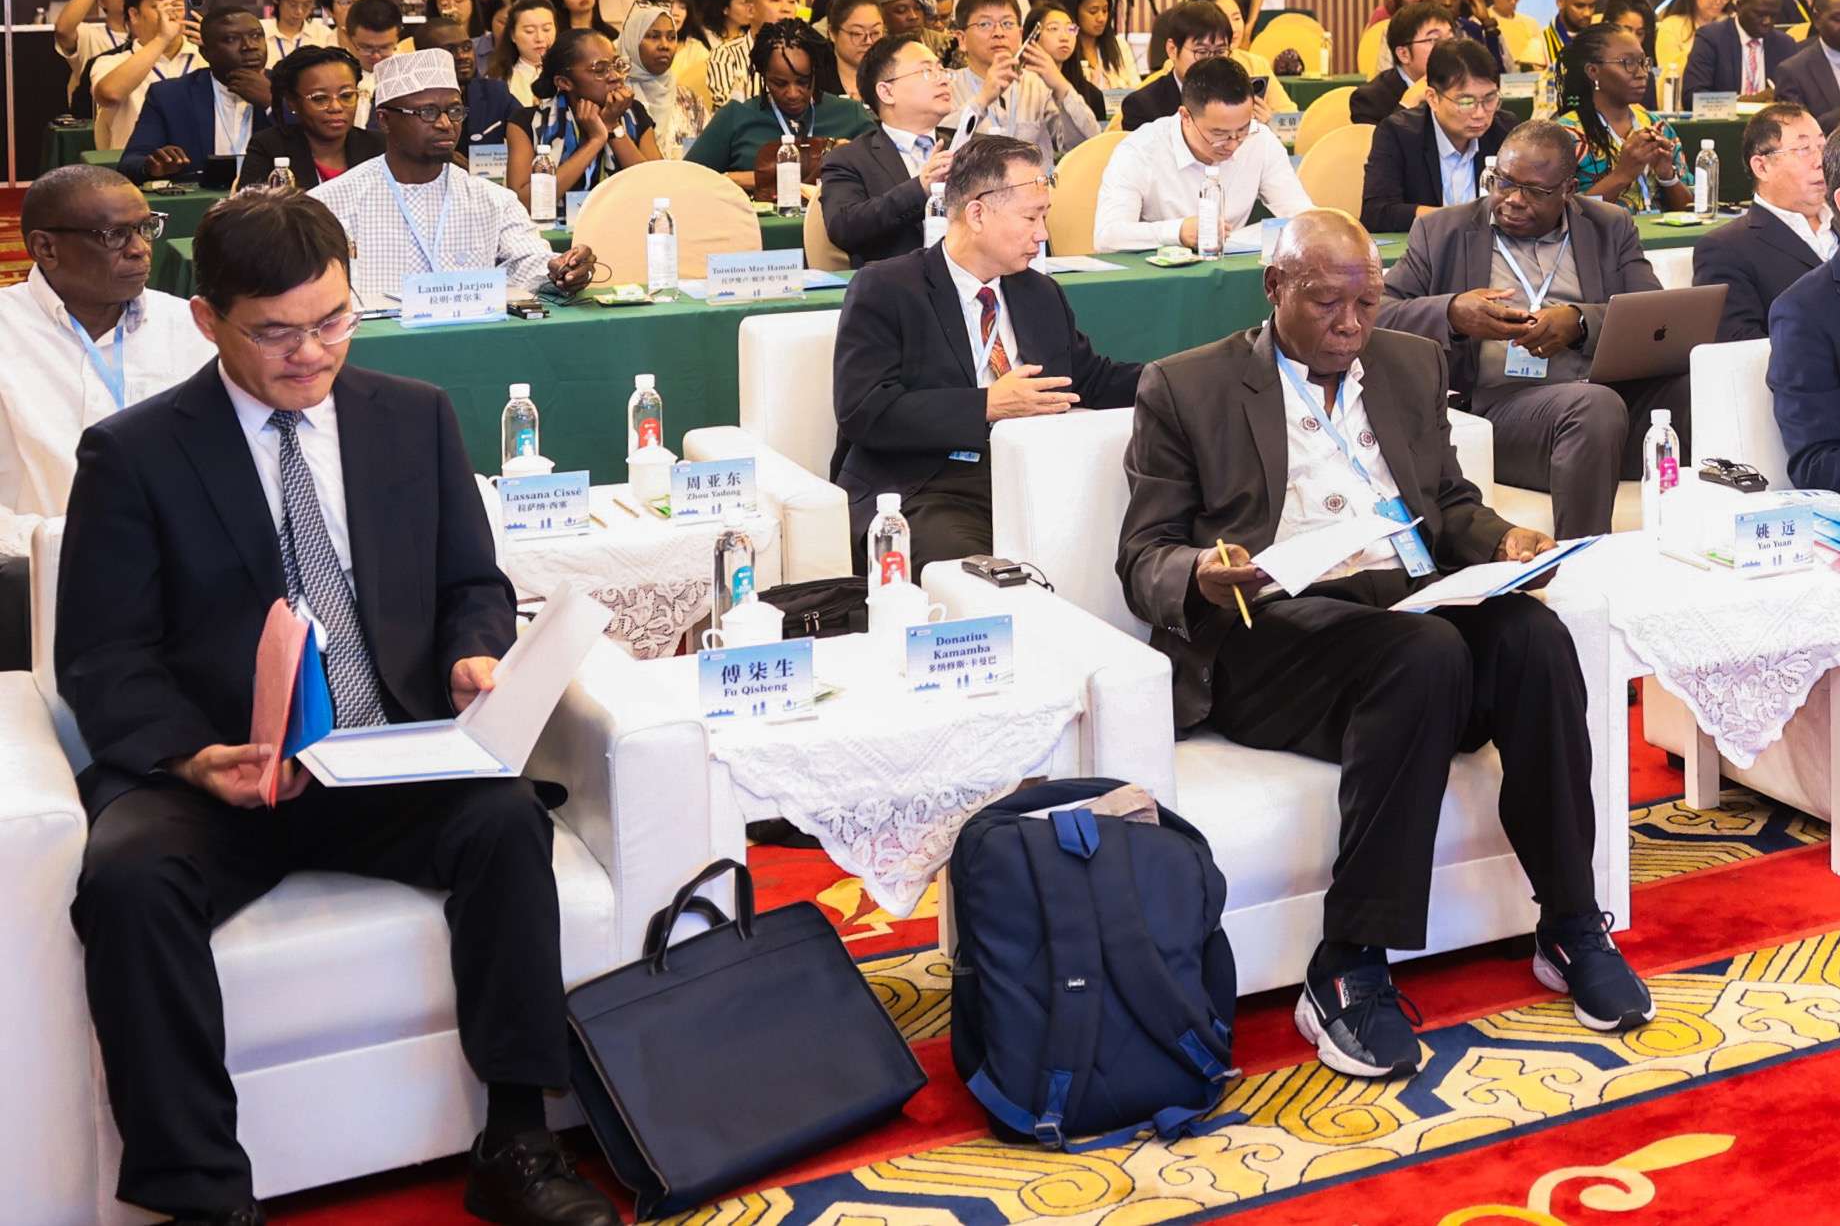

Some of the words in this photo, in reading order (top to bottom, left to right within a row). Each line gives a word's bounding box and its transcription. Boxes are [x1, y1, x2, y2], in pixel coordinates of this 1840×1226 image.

[417, 283, 454, 294] Lamin
[457, 281, 493, 292] Jarjou
[506, 491, 550, 502] Lassana
[1773, 539, 1792, 548] Yuan
[936, 631, 988, 646] Donatius
[933, 644, 991, 660] Kamamba
[724, 687, 737, 697] Fu
[741, 682, 788, 695] Qisheng
